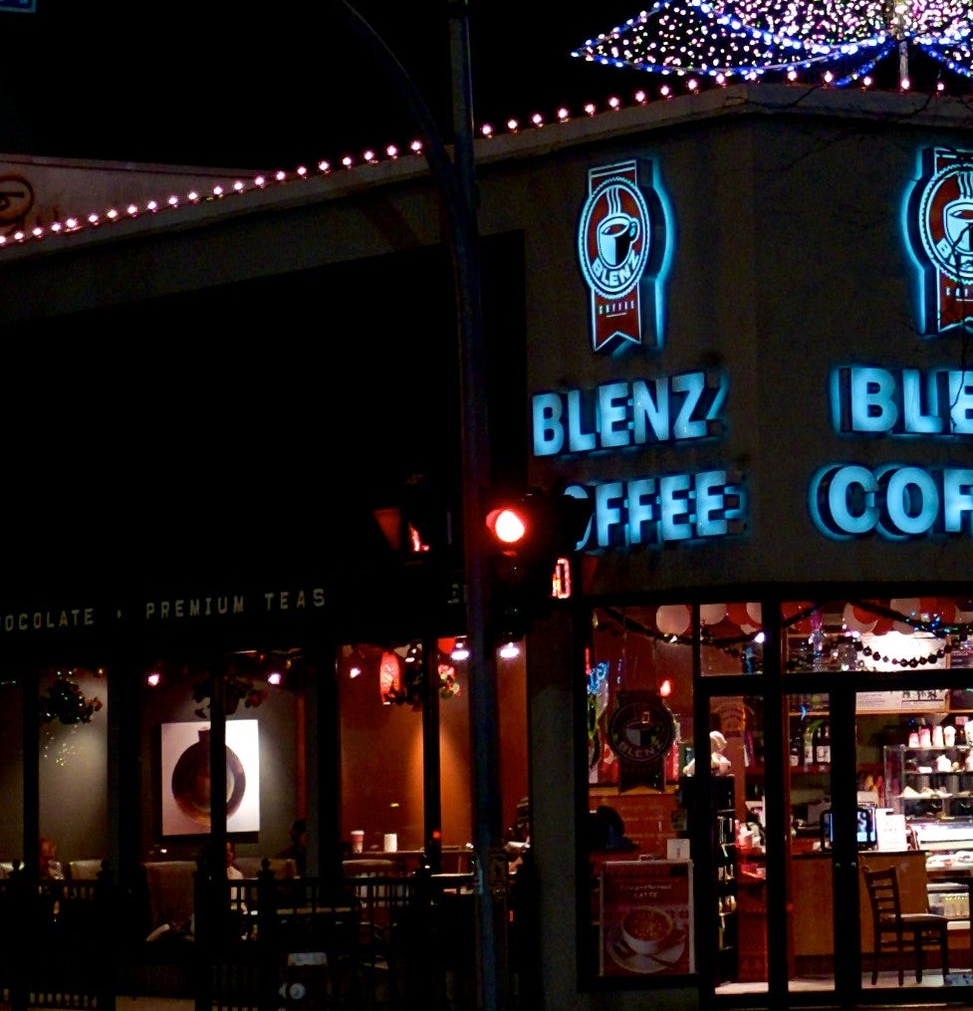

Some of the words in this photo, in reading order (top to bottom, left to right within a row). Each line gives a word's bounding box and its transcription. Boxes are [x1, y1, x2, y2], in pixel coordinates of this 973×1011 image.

[592, 250, 639, 286] BLENZ
[532, 372, 708, 457] BLENZ
[563, 470, 729, 551] FFEE
[0, 607, 94, 632] OCOLATE
[145, 593, 246, 620] PREMIUM
[264, 588, 326, 611] TEAS
